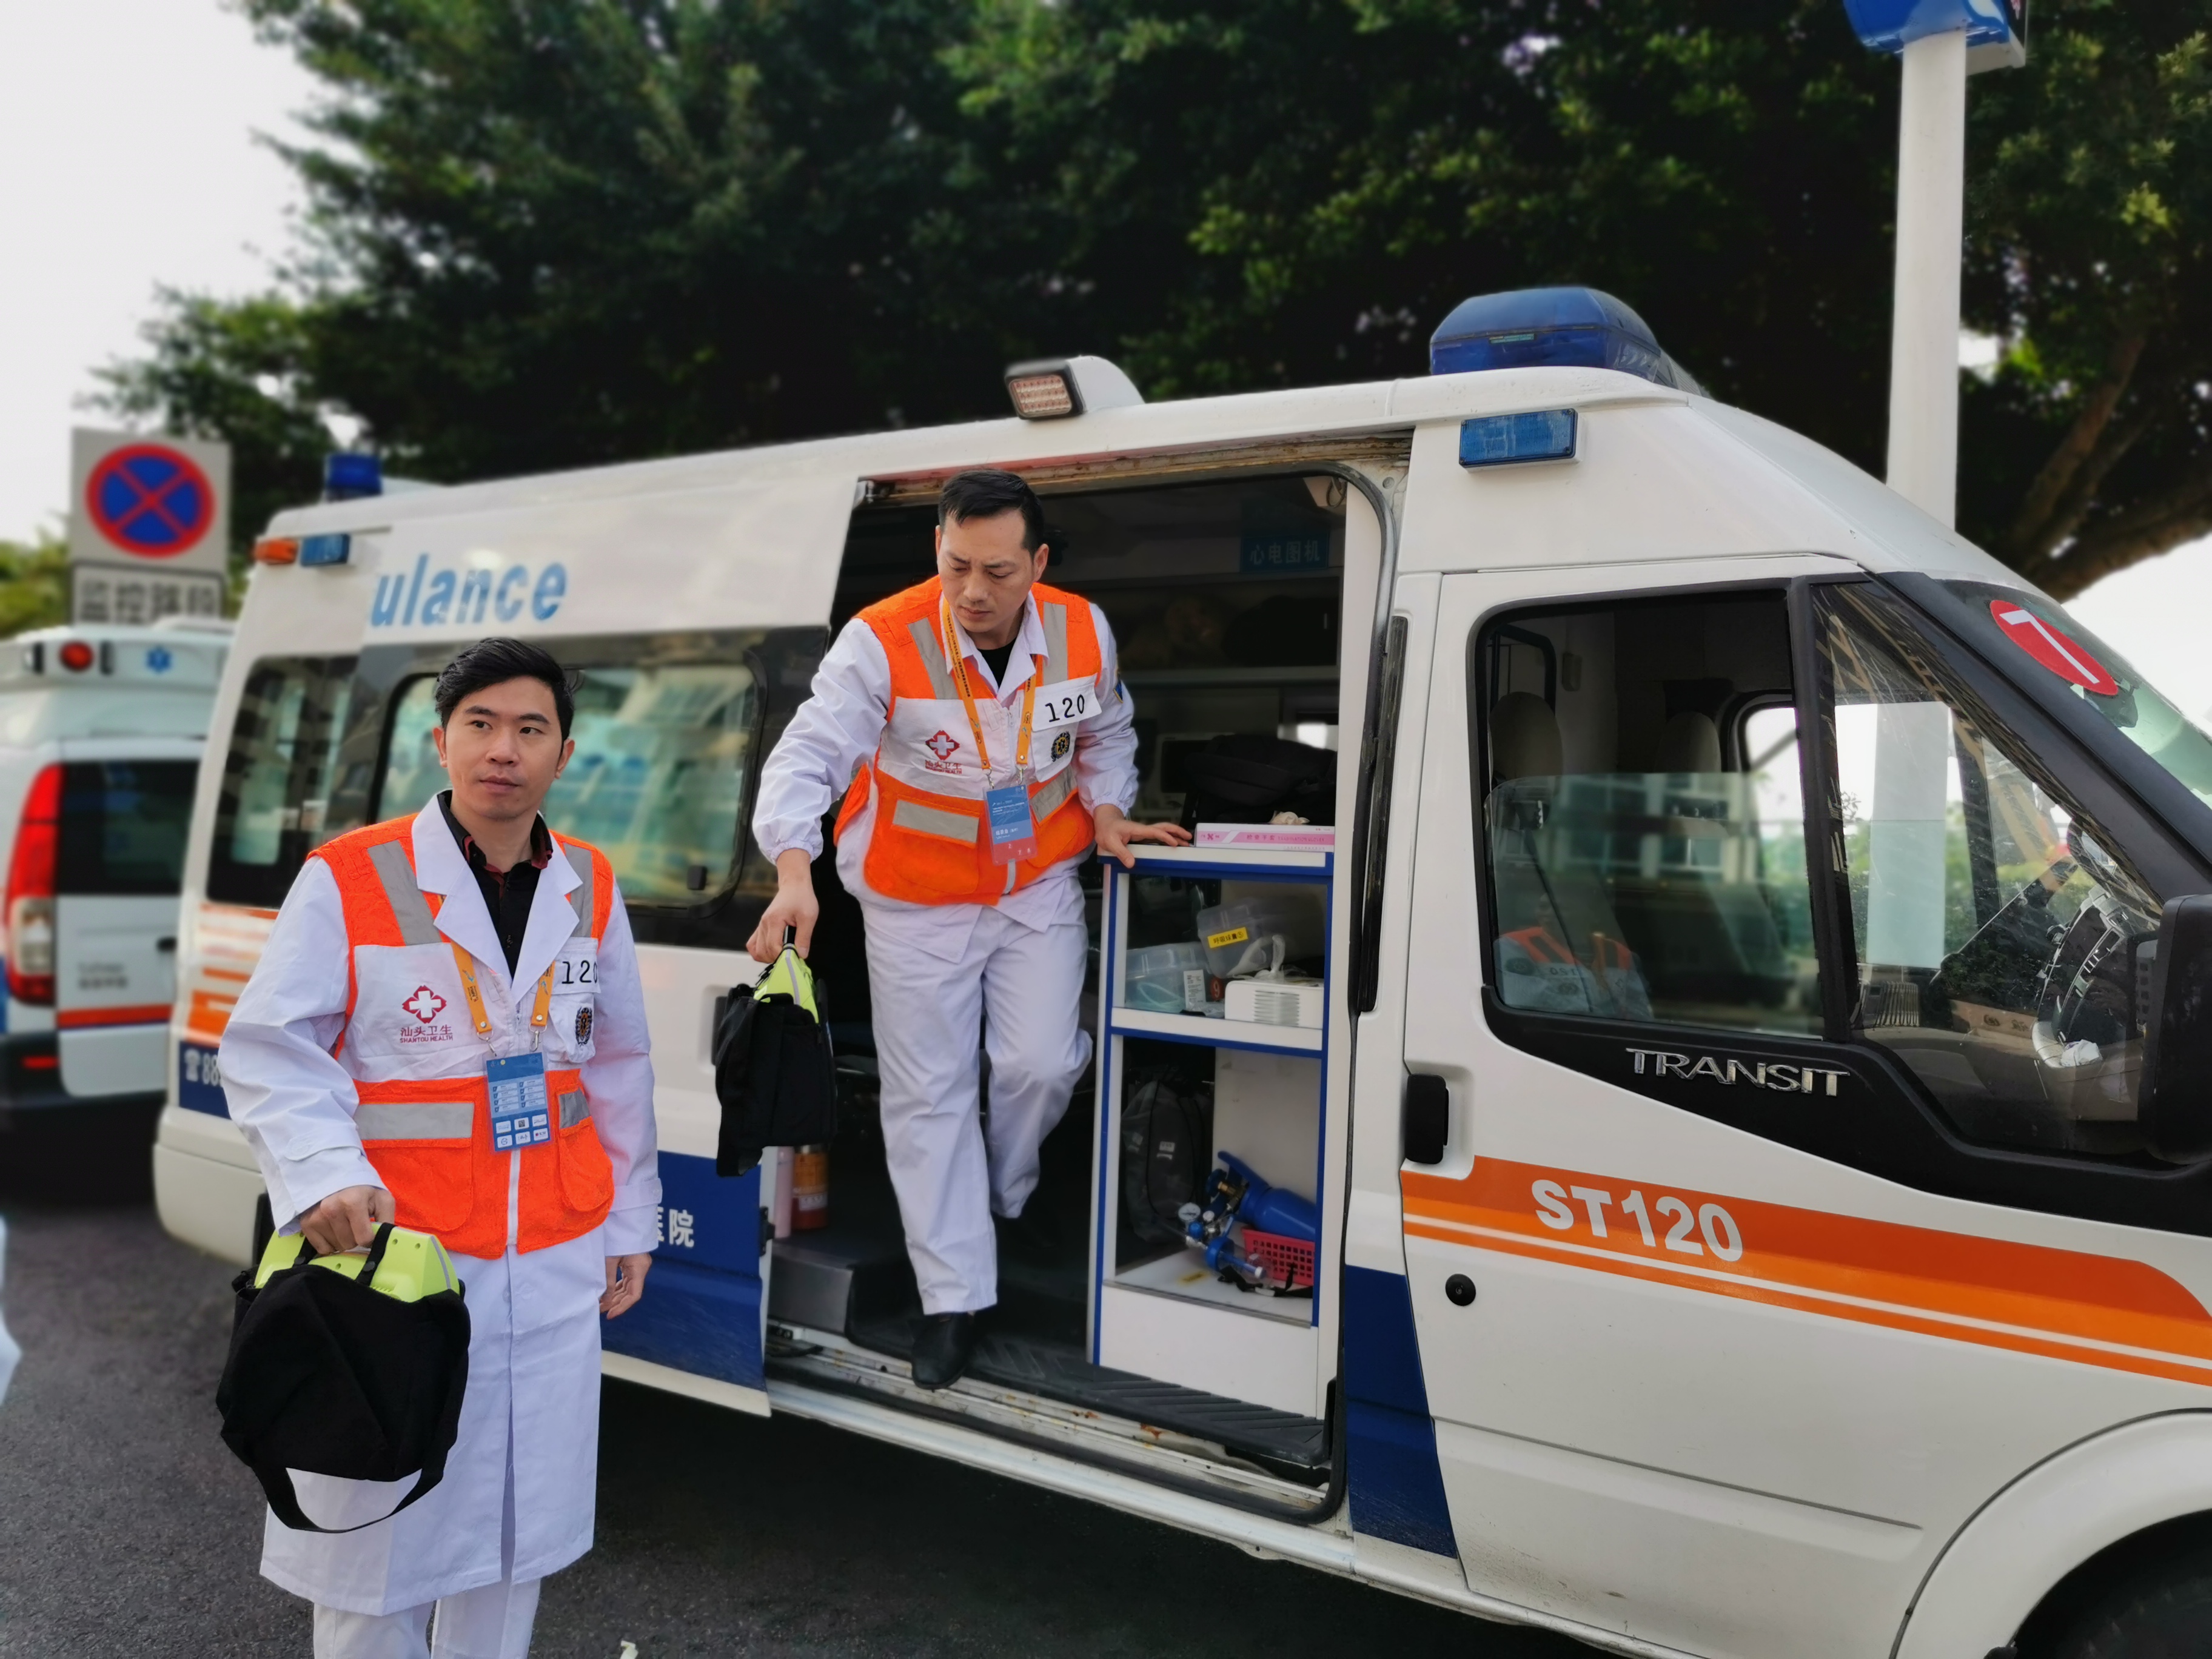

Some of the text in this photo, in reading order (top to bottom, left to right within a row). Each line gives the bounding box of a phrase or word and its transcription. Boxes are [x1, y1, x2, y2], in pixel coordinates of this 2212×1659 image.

[1249, 540, 1320, 565] 心电图机
[370, 552, 568, 627] ulance
[1045, 694, 1085, 722] 120
[400, 1024, 453, 1037] 汕头卫生
[1625, 1047, 1851, 1098] TRANSIT
[1530, 1179, 1744, 1262] ST120
